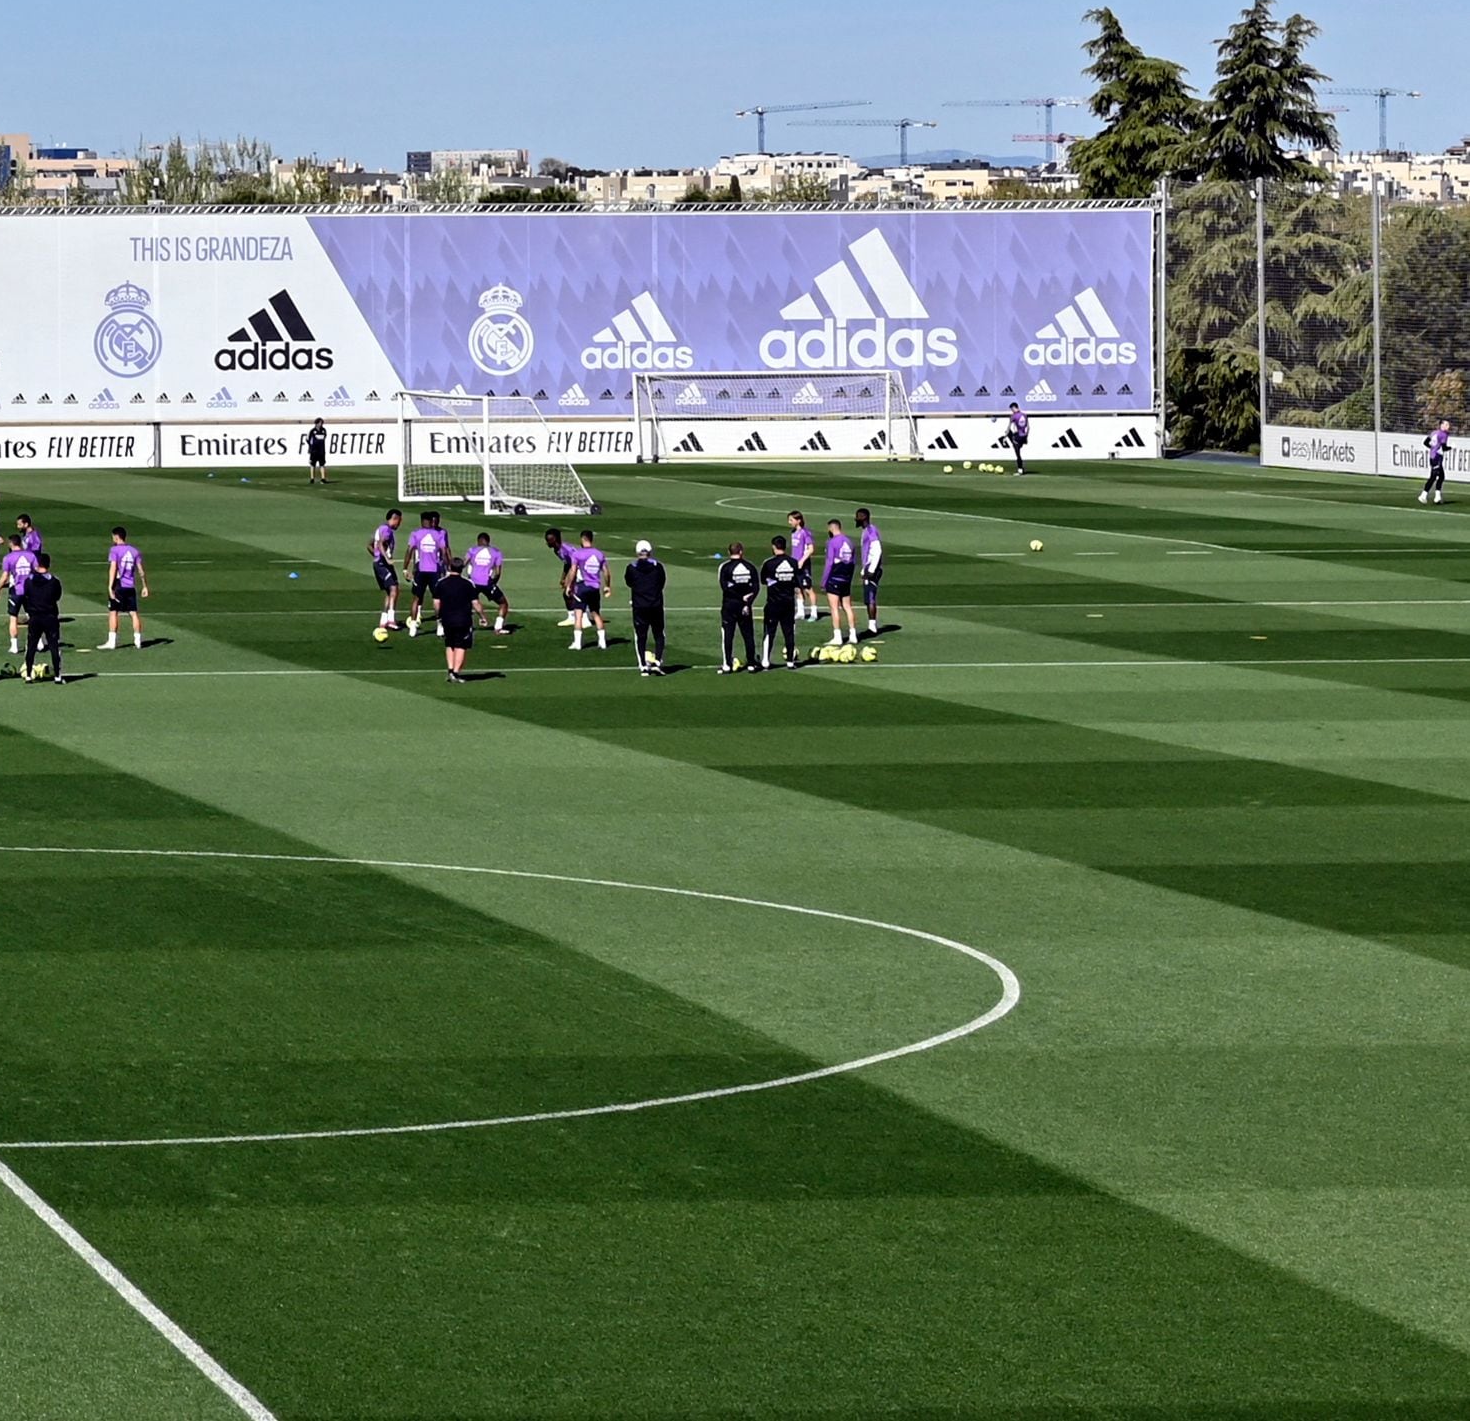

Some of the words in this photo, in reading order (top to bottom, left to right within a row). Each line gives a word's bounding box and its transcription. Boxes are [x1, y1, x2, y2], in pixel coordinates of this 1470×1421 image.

[130, 237, 170, 261] THIS
[176, 237, 191, 261] IS
[196, 237, 293, 261] GRANDEZA
[581, 341, 693, 369] adidas
[759, 318, 958, 370] adidas
[1024, 337, 1137, 365] adidas
[215, 341, 333, 371] adidas
[88, 400, 120, 409] adidas
[206, 400, 237, 408] adidas
[324, 399, 355, 407] adidas
[558, 397, 590, 406] adidas
[1025, 394, 1056, 402] adidas
[48, 437, 76, 458] FLY
[79, 436, 134, 458] BETTER
[181, 434, 287, 455] Emirates
[329, 433, 385, 455] BETTER
[547, 432, 577, 452] FLY
[578, 432, 633, 452] BETTER
